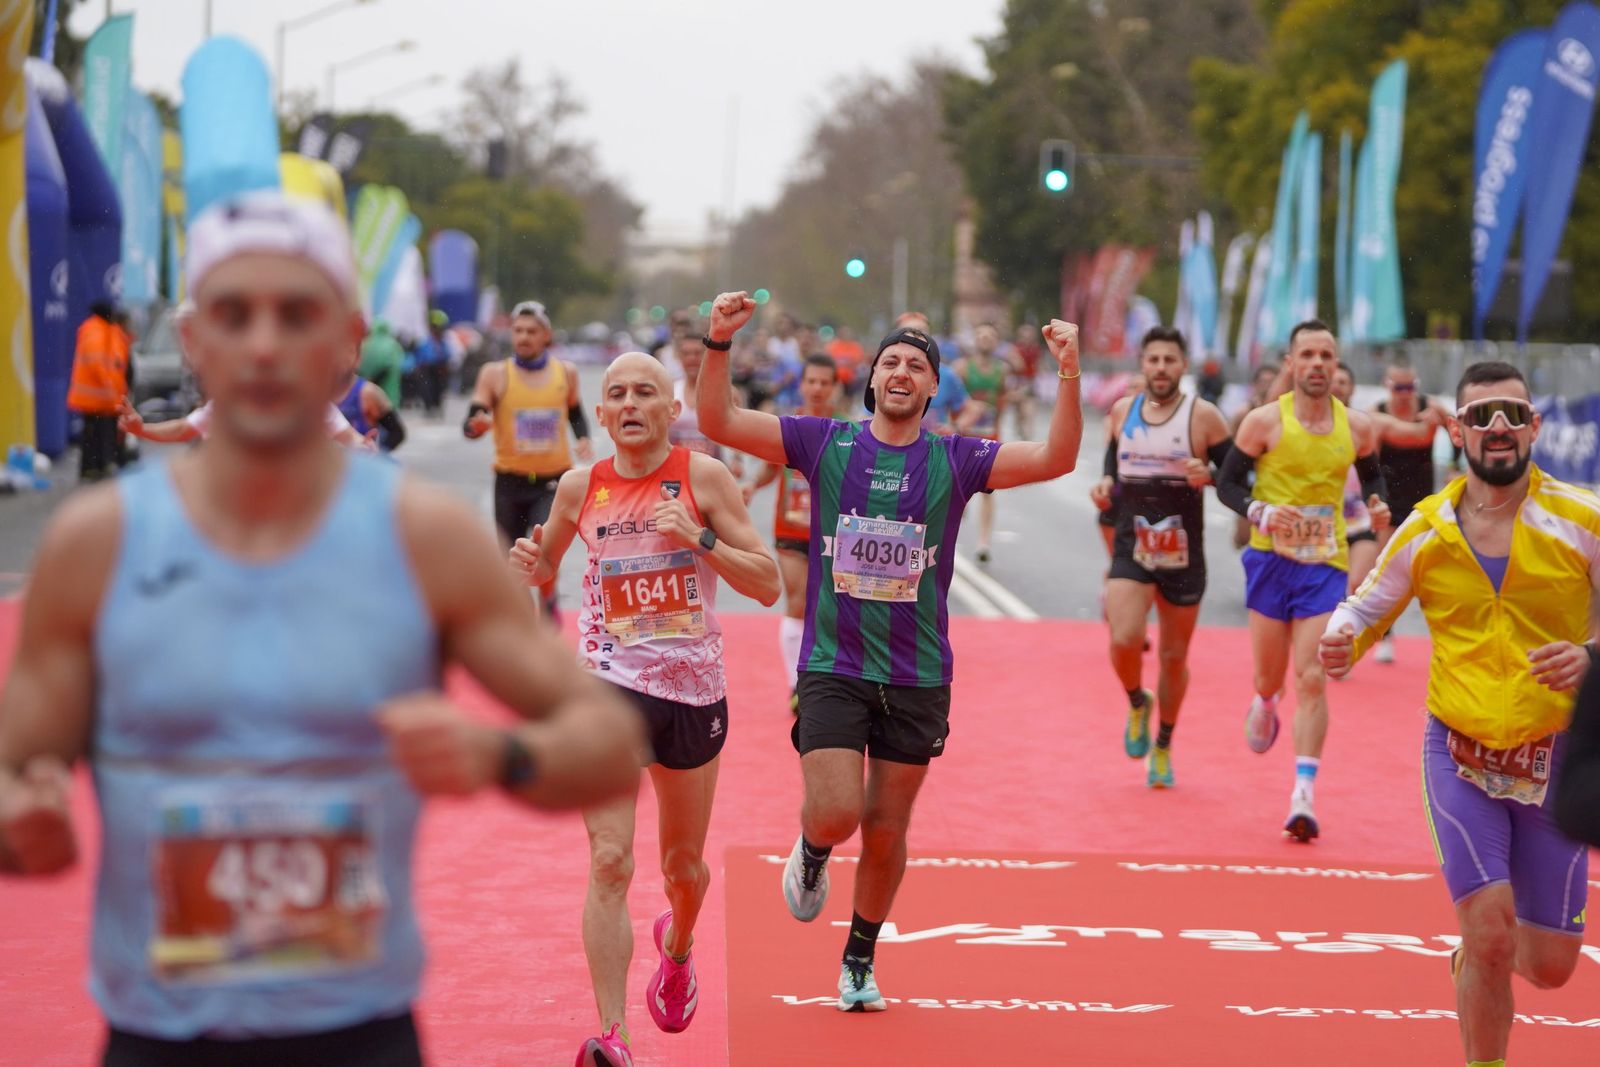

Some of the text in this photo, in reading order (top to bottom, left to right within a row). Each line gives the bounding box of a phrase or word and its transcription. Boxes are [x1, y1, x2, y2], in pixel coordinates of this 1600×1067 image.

[1473, 85, 1533, 229] progress
[850, 538, 907, 567] 4030
[621, 574, 680, 607] 1641
